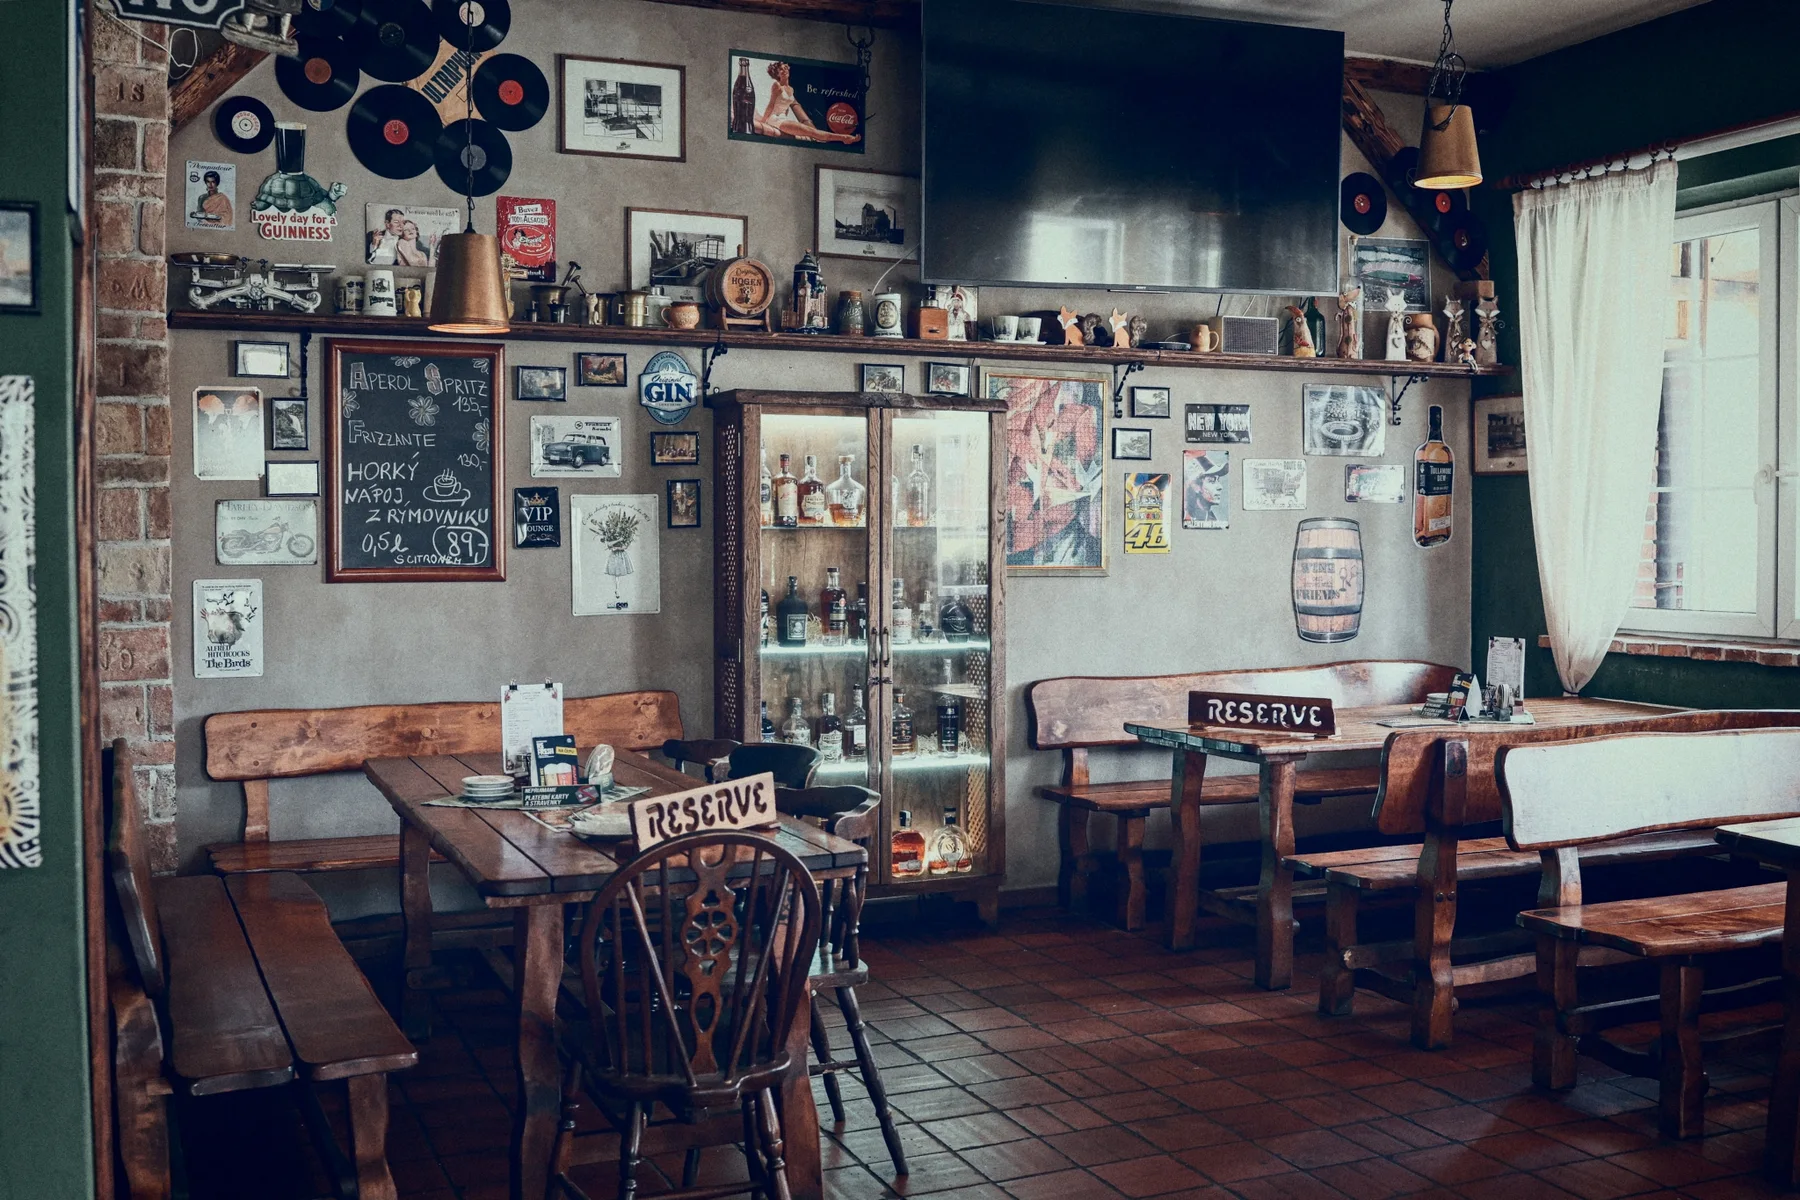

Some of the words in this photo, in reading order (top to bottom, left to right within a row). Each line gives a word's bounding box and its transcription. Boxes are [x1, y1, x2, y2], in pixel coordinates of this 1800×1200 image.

[807, 84, 817, 94] Be
[820, 87, 859, 99] refreshed
[253, 213, 286, 226] Lovely
[290, 213, 309, 225] day
[312, 213, 327, 224] for
[330, 217, 336, 225] a
[262, 223, 331, 240] GUINNESS
[350, 361, 419, 391] APEROL
[424, 362, 488, 397] SPRITZ
[644, 382, 693, 403] GIN
[1187, 412, 1216, 431] NEW
[1218, 413, 1249, 431] YORK
[348, 420, 436, 447] FRIZZANTE
[348, 451, 420, 482] HORKÝ
[345, 484, 403, 504] NÁPOJ
[365, 508, 381, 523] Z
[520, 506, 553, 522] VIP
[1125, 523, 1168, 549] 46
[1207, 699, 1322, 728] RESERVE
[646, 782, 768, 840] RESERVE
